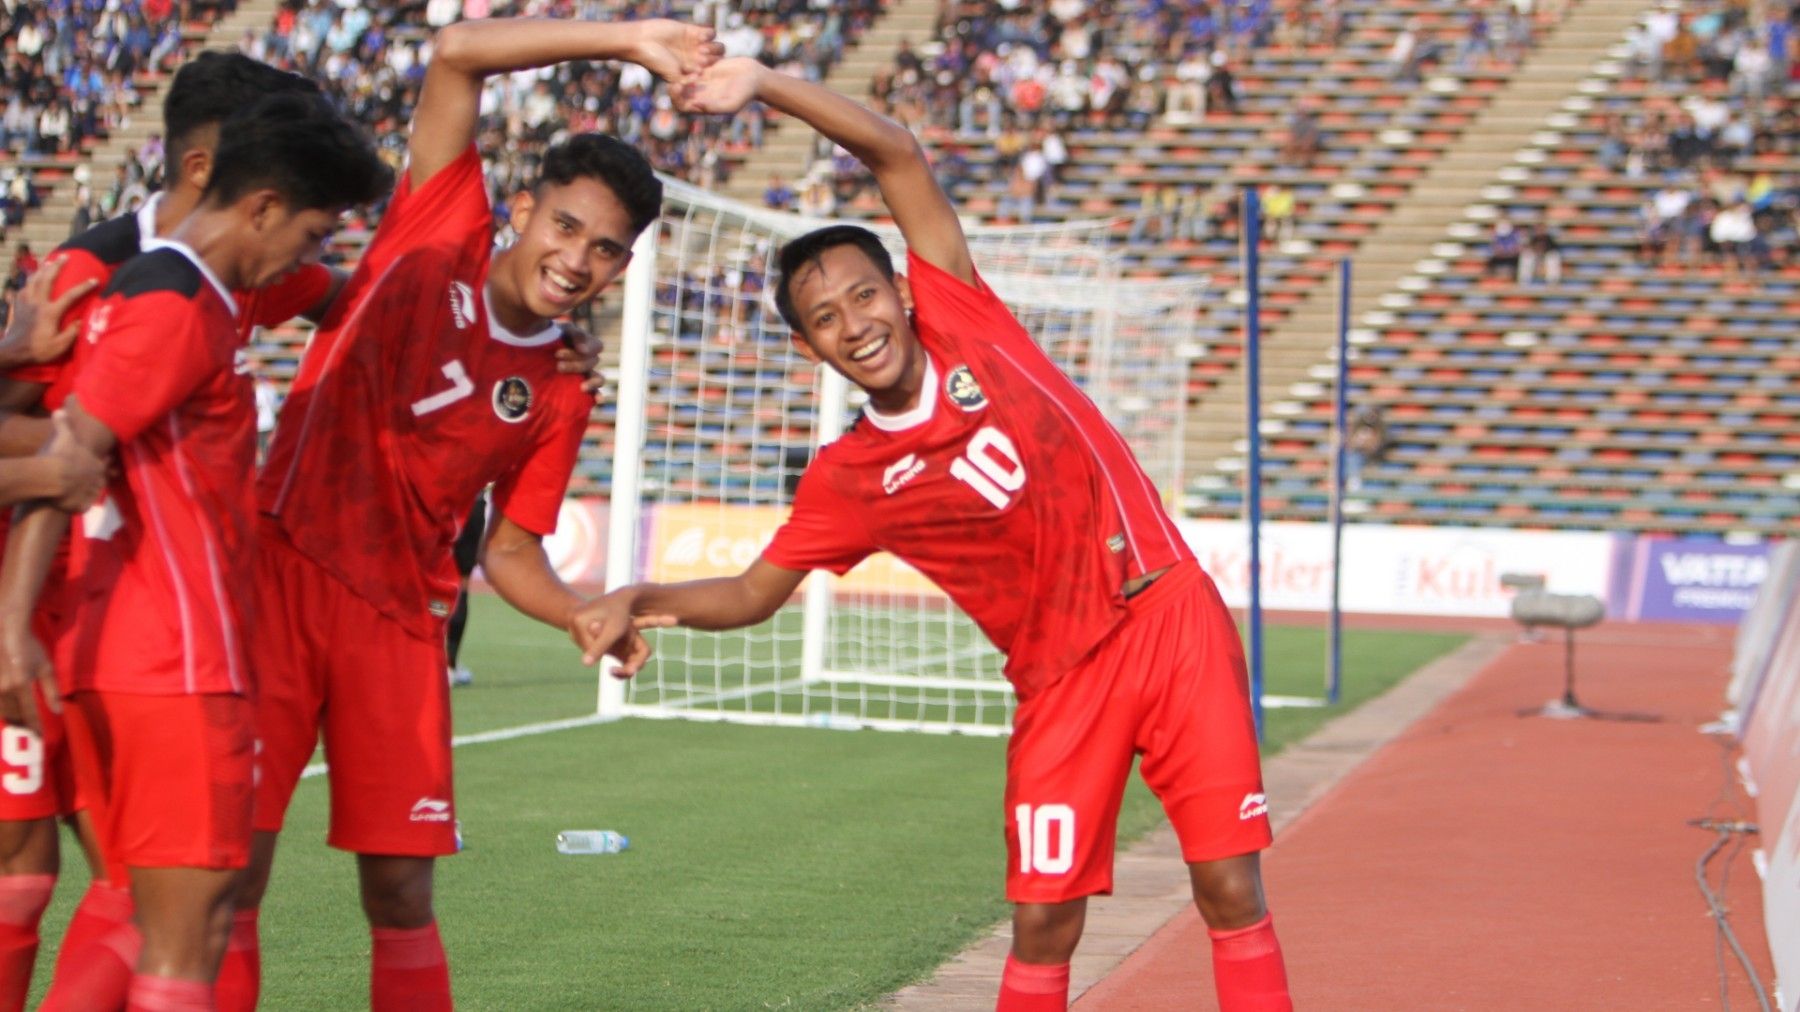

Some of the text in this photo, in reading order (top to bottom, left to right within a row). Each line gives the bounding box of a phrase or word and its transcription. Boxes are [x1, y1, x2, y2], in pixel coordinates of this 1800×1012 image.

[411, 359, 475, 416] 7
[949, 426, 1026, 510] 10
[1, 725, 44, 794] 9
[1016, 803, 1076, 874] 10
